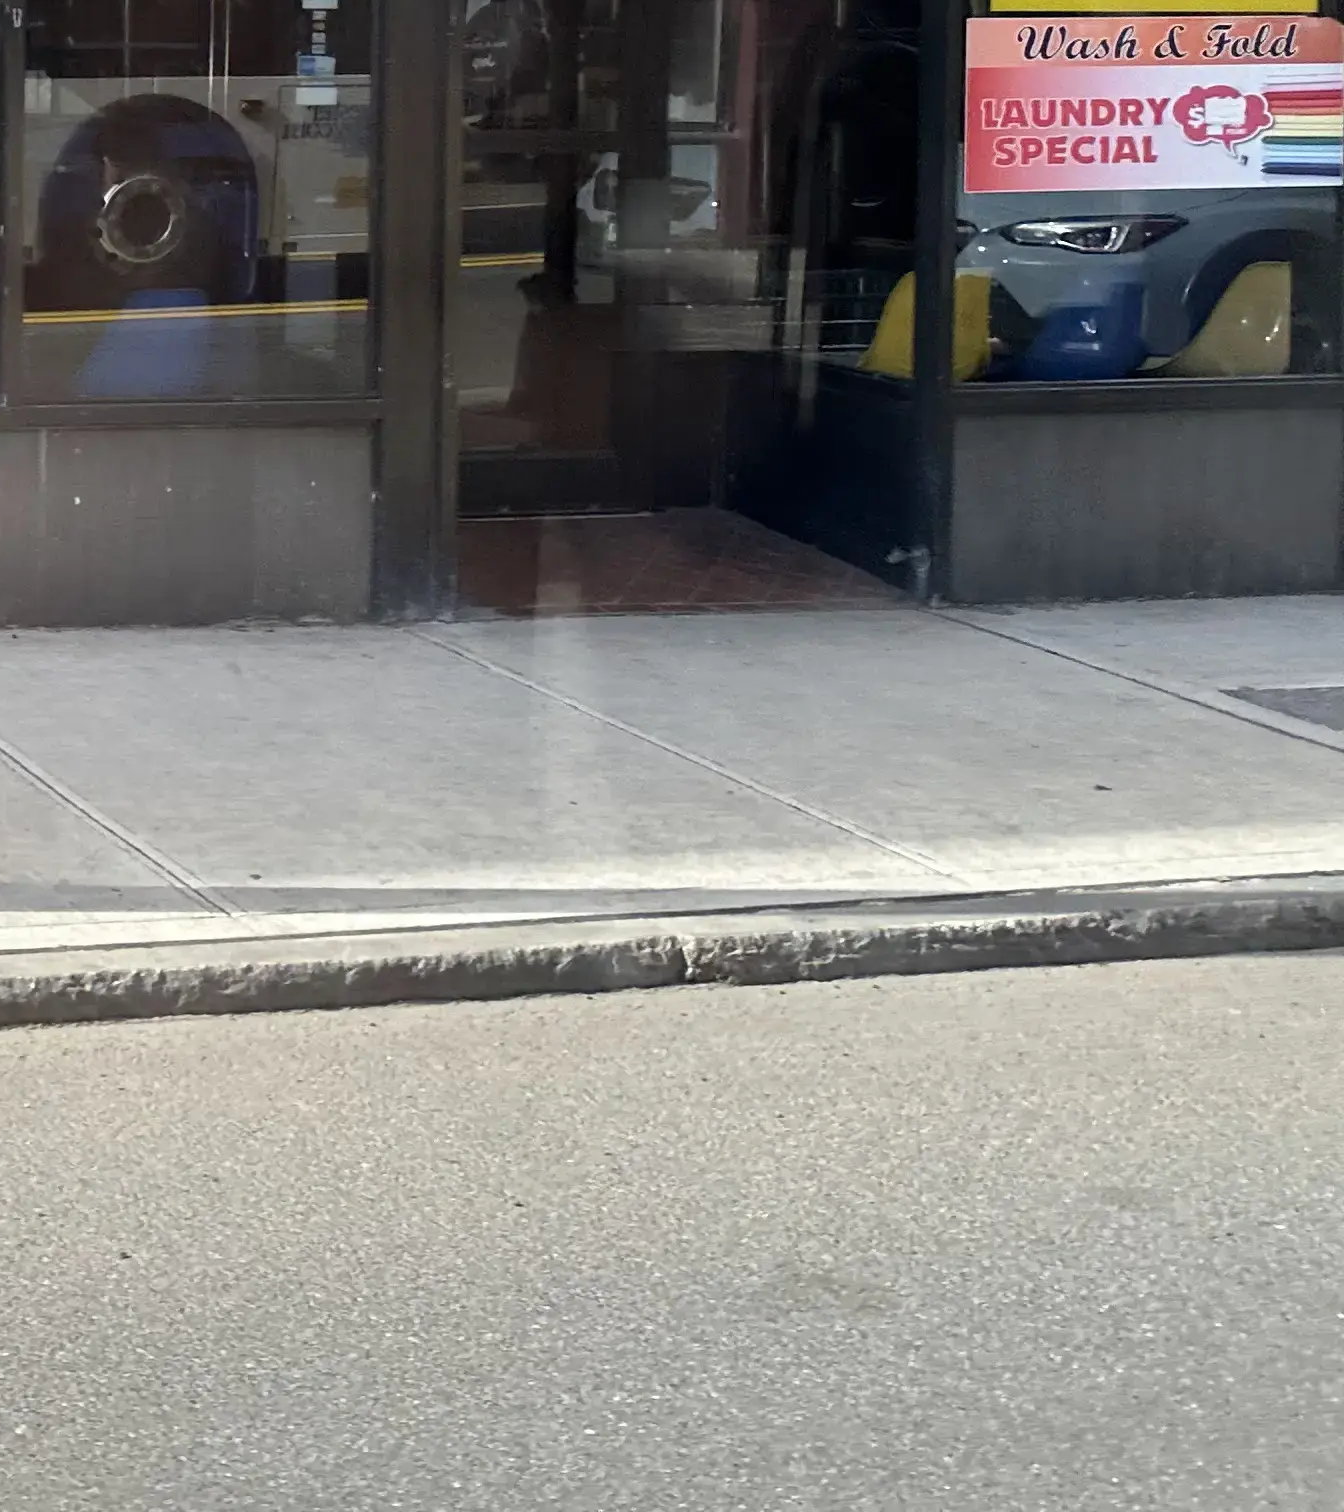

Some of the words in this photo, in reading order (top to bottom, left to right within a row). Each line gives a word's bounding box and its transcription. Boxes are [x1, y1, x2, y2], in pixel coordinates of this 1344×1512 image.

[1017, 24, 1141, 60] Wash
[1155, 24, 1188, 59] &
[1202, 22, 1299, 59] Fold
[980, 97, 1172, 129] LAUNDRY
[992, 134, 1159, 168] SPECIAL
